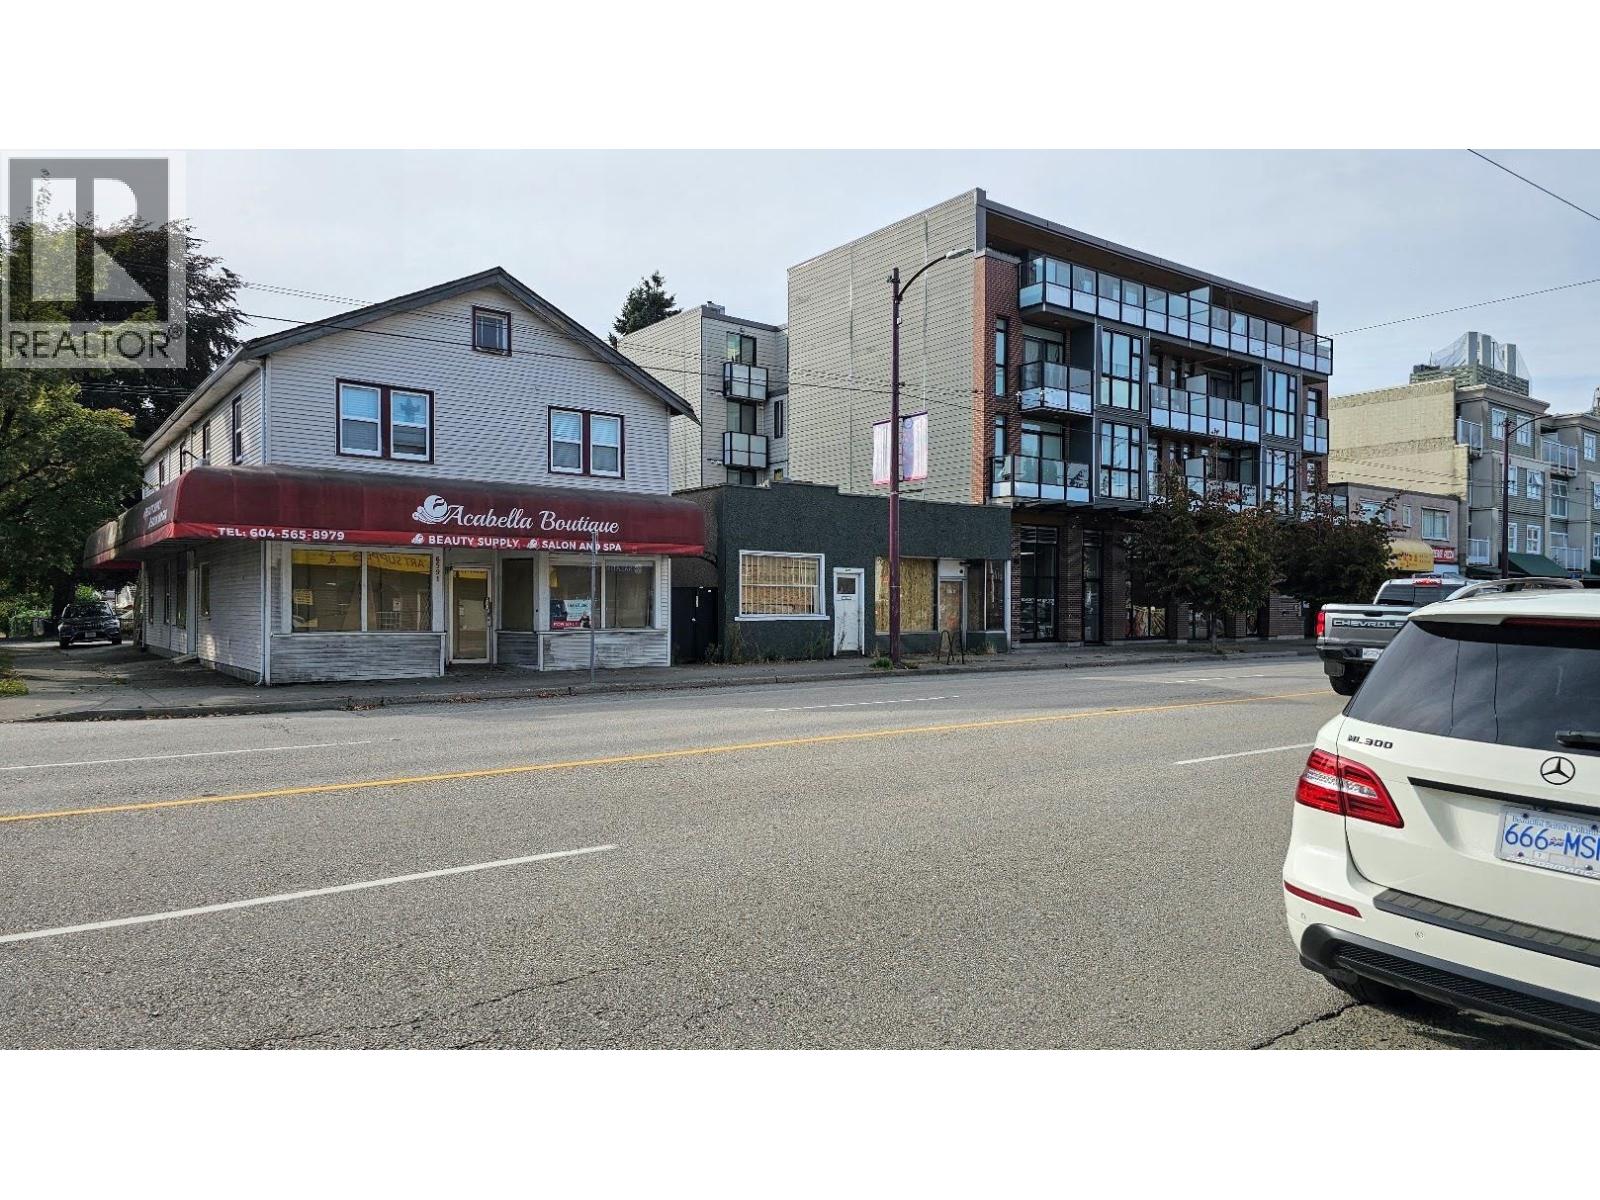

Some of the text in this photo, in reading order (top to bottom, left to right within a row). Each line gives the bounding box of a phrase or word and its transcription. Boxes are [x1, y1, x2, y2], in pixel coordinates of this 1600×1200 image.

[442, 504, 620, 534] Acabella Boutique
[217, 527, 345, 541] TEL: 604-565-8979
[428, 535, 519, 548] BEAUTY SUPPLY
[541, 540, 577, 550] SALON
[603, 543, 622, 552] SPA
